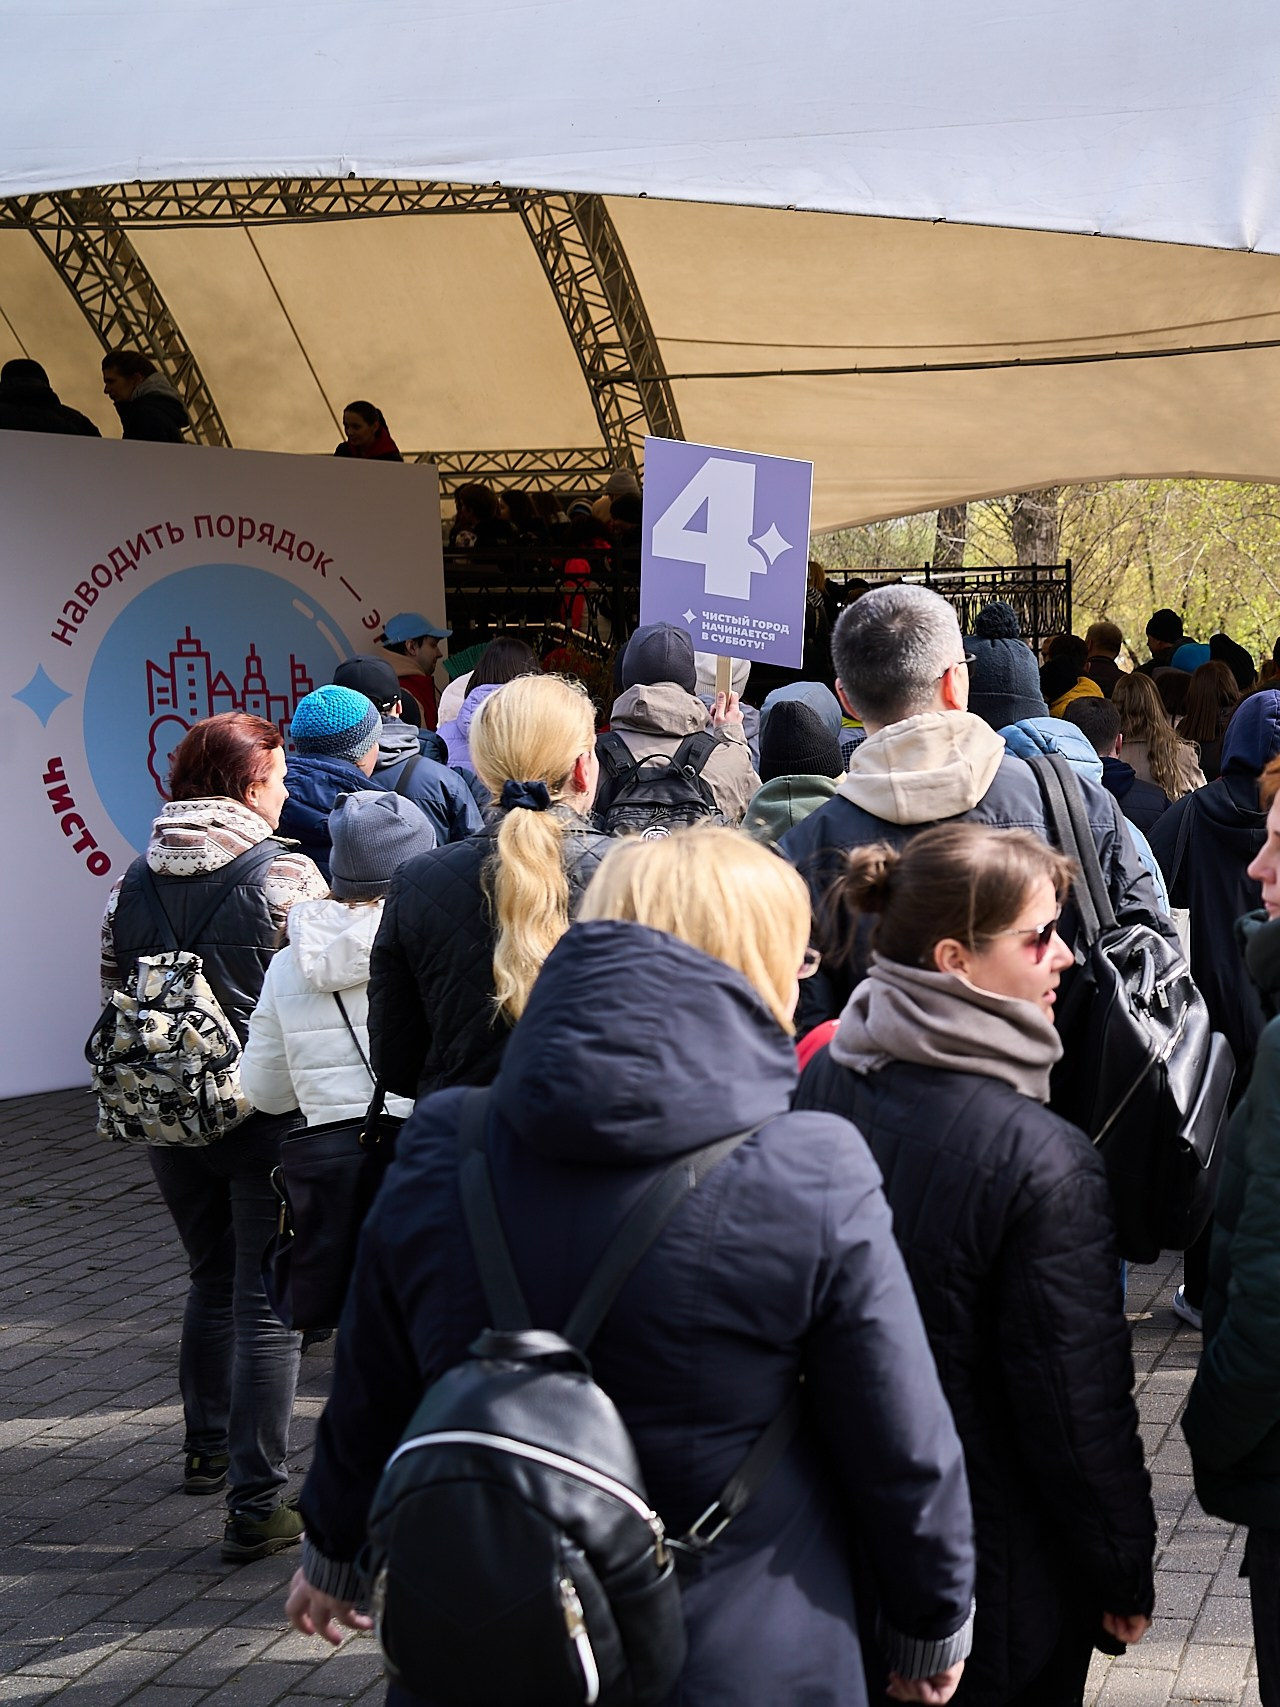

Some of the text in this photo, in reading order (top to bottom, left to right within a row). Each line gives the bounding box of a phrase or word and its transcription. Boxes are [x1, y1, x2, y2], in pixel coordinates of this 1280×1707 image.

[652, 457, 767, 601] 4
[50, 521, 185, 646] наводить
[193, 514, 334, 578] порядок
[701, 621, 776, 641] НАЧИНАЕТСЯ
[702, 611, 790, 635] ЧИСТЫЙ ГОРОД
[701, 632, 765, 650] В СУББОТУ!
